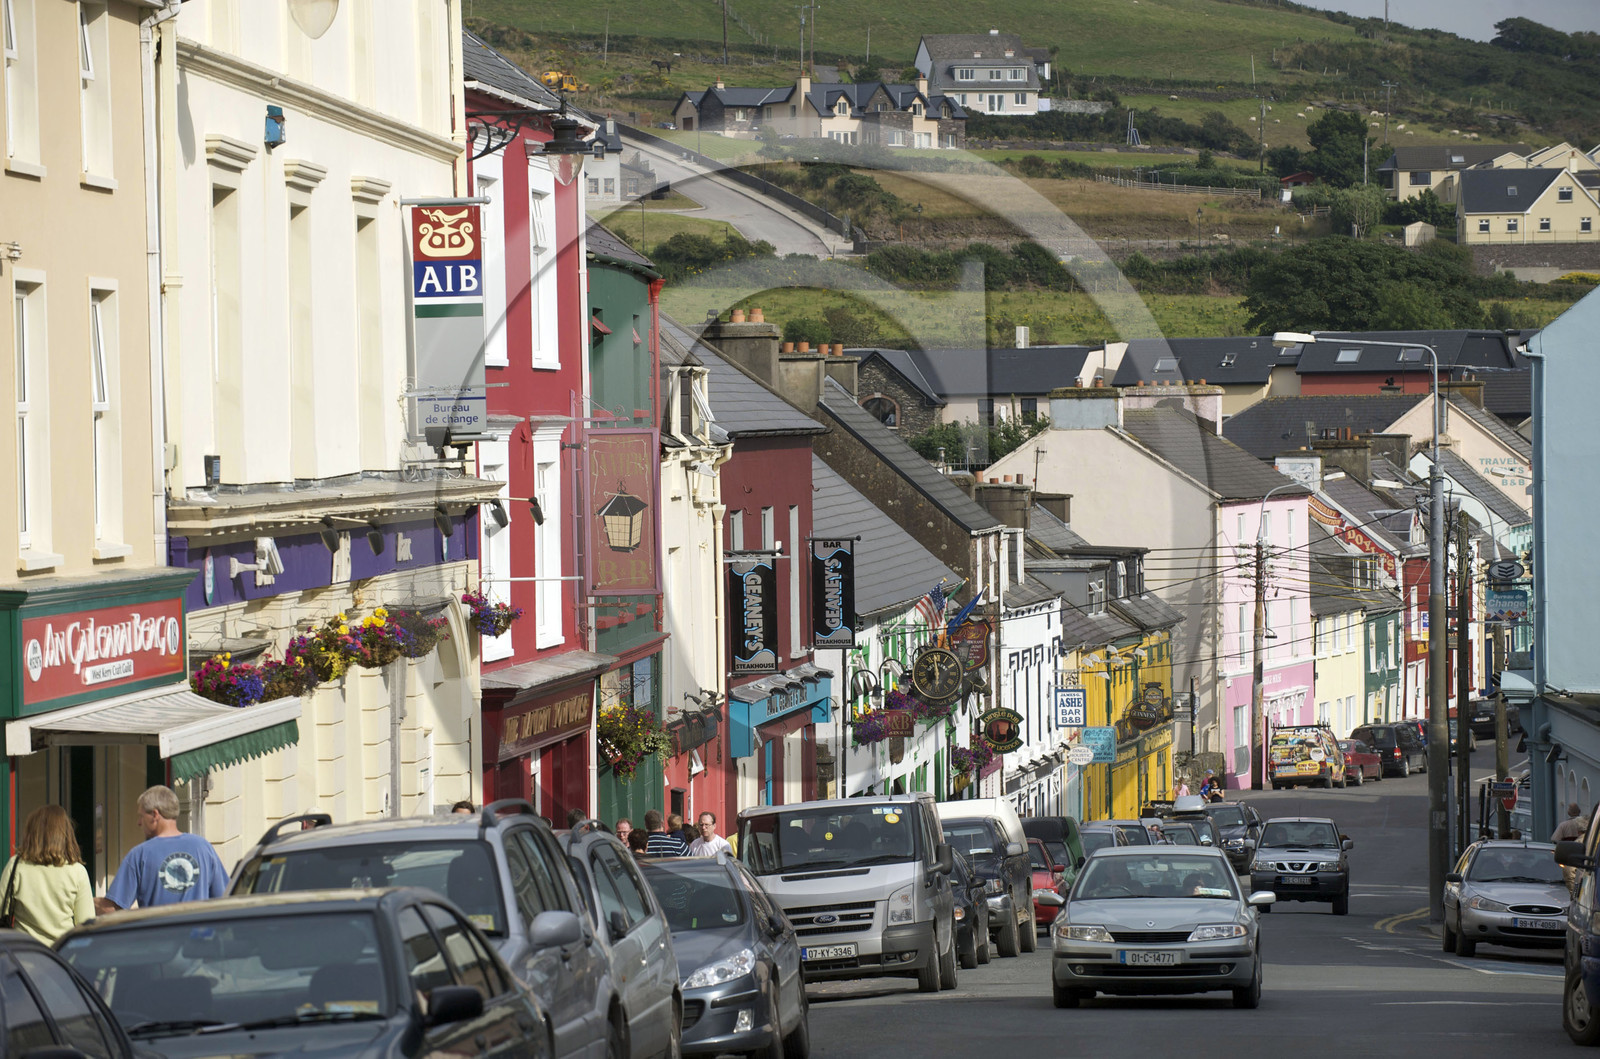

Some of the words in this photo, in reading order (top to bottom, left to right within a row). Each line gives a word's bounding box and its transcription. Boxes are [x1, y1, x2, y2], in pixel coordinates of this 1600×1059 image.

[419, 265, 479, 293] AIB
[433, 404, 470, 413] Bureau
[425, 415, 438, 424] de
[442, 414, 479, 425] change
[1479, 457, 1519, 465] TRAVEL
[823, 541, 842, 549] BAR
[825, 558, 842, 629] GEANEY'S
[1488, 599, 1526, 609] Change
[745, 573, 764, 652] GEANEY'S
[92, 669, 102, 680] West
[112, 664, 122, 676] Craft
[1059, 698, 1083, 708] ASHE
[1131, 709, 1156, 719] GUINNESS
[808, 946, 852, 958] 07-KY-3346
[1131, 953, 1175, 963] 01-C-14771
